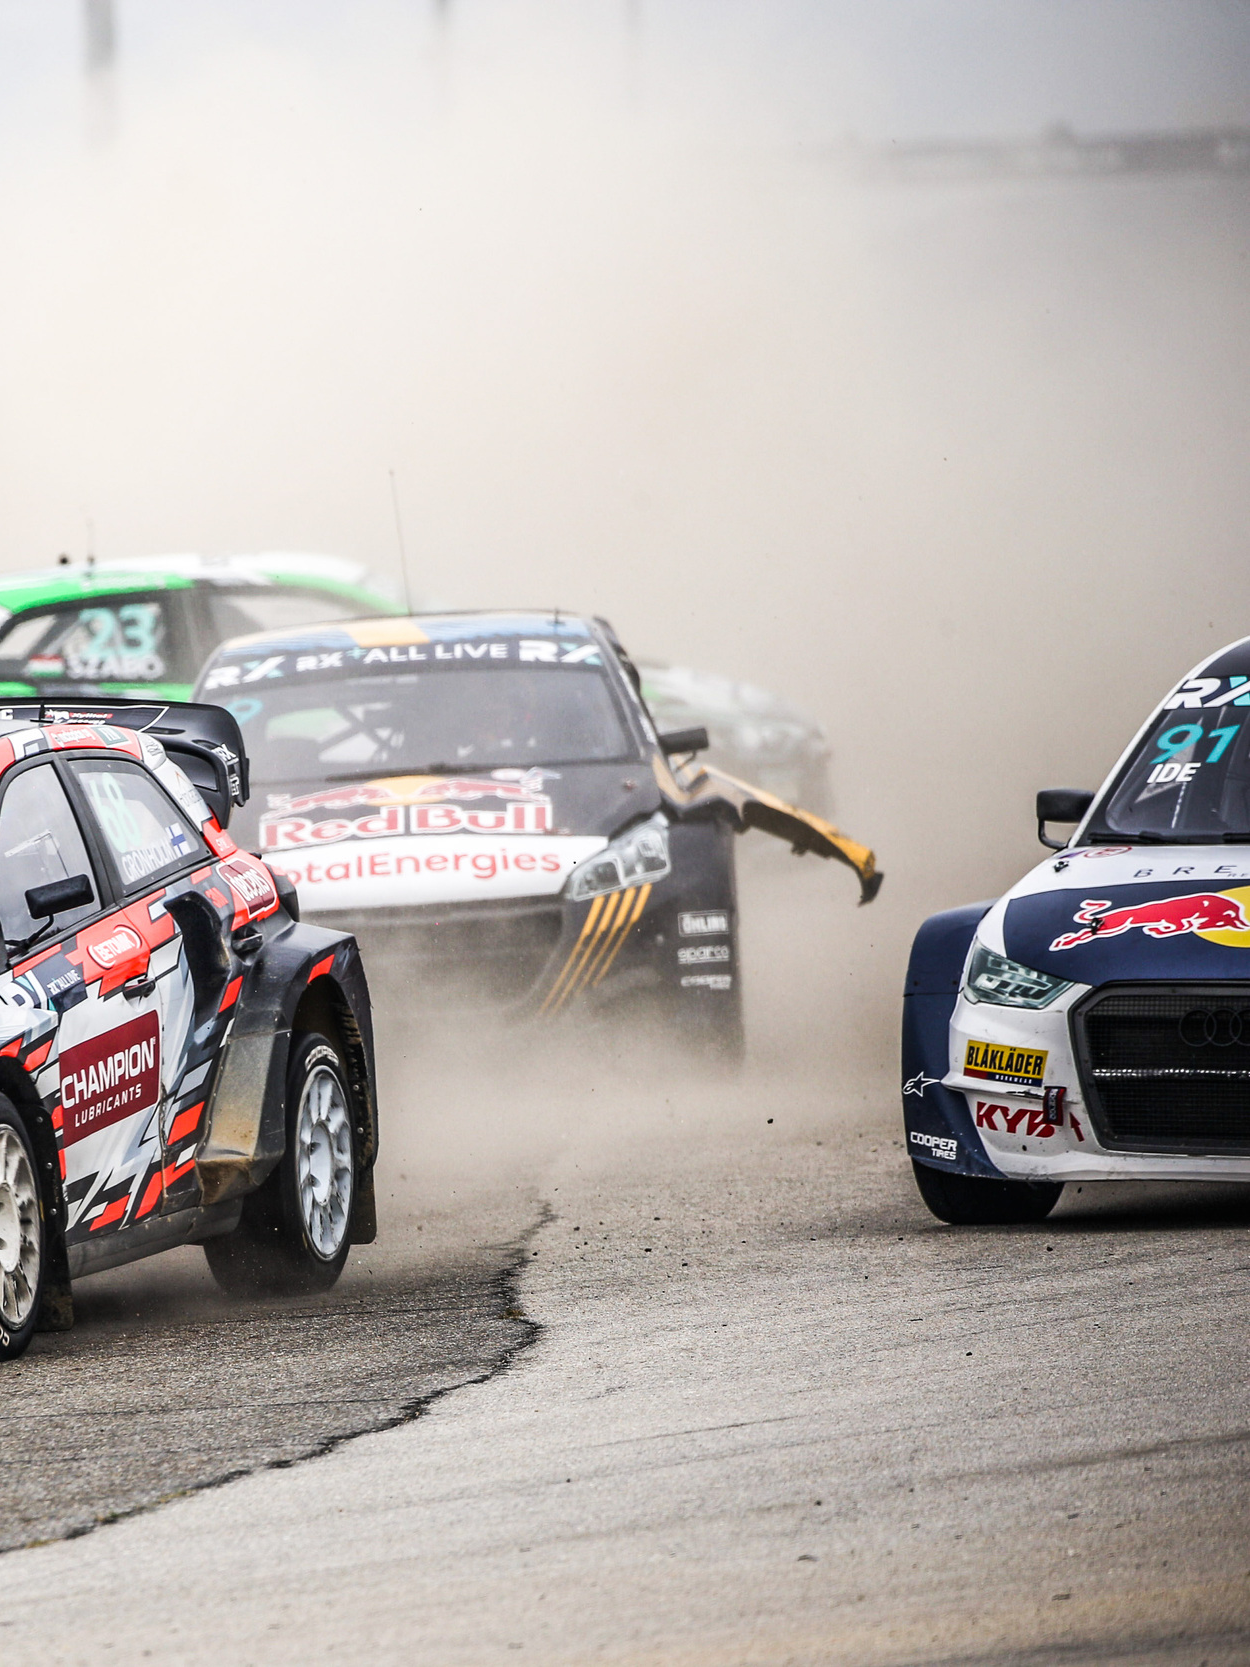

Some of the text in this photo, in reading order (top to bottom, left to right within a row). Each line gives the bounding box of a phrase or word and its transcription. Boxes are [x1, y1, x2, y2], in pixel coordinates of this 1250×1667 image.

[79, 604, 155, 657] 23
[205, 655, 285, 689] RX
[435, 643, 507, 660] LIVE
[519, 639, 602, 666] RX
[1164, 676, 1250, 709] RX
[1150, 724, 1240, 764] 91
[1147, 763, 1201, 783] IDE
[90, 772, 142, 853] 68
[261, 802, 551, 848] Red Bull
[287, 849, 561, 884] otalEnergies
[61, 1038, 155, 1109] CHAMPION
[966, 1043, 1044, 1076] BLÅKLÄDER
[995, 1074, 1033, 1085] WORKWEAR
[74, 1083, 142, 1128] LUBRICANTS
[910, 1132, 958, 1151] COOPER
[931, 1147, 957, 1160] TIRES
